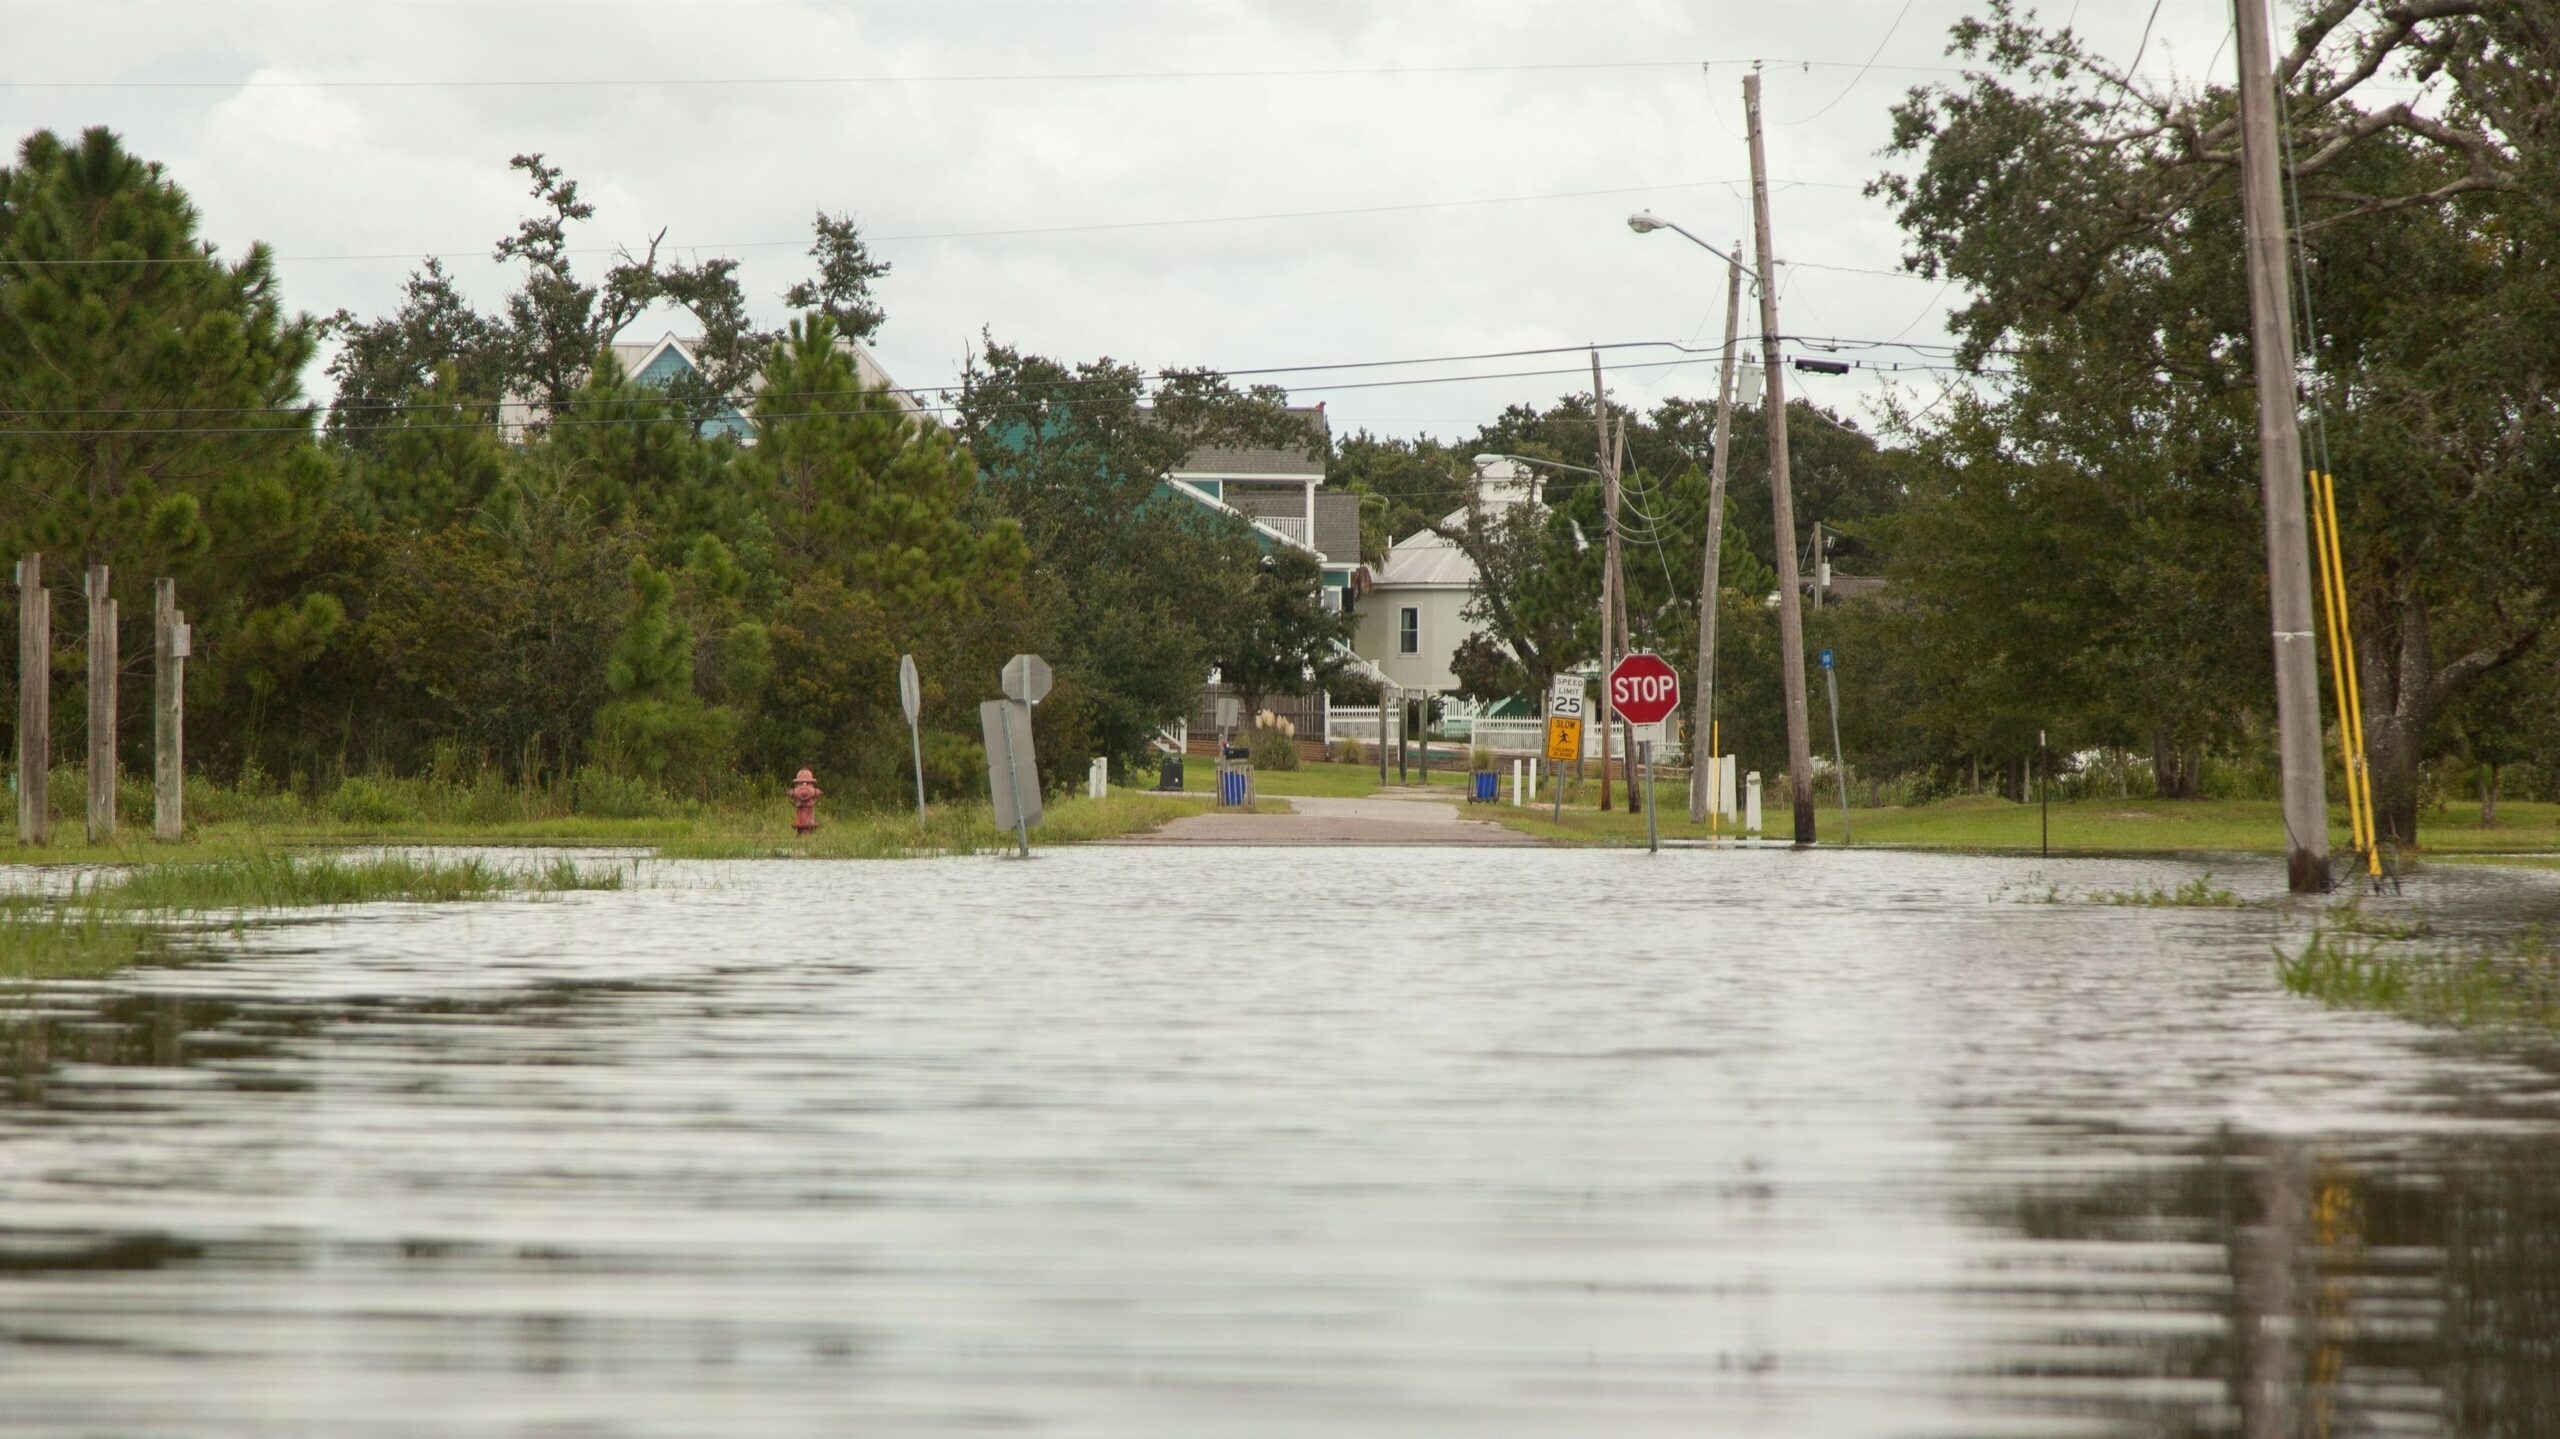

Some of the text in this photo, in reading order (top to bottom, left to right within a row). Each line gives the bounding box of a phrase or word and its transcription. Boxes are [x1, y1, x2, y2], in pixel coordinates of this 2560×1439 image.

[1557, 678, 1583, 687] SPEED
[1615, 675, 1674, 703] STOP
[1554, 696, 1580, 713] 25
[1556, 720, 1575, 728] SLOW
